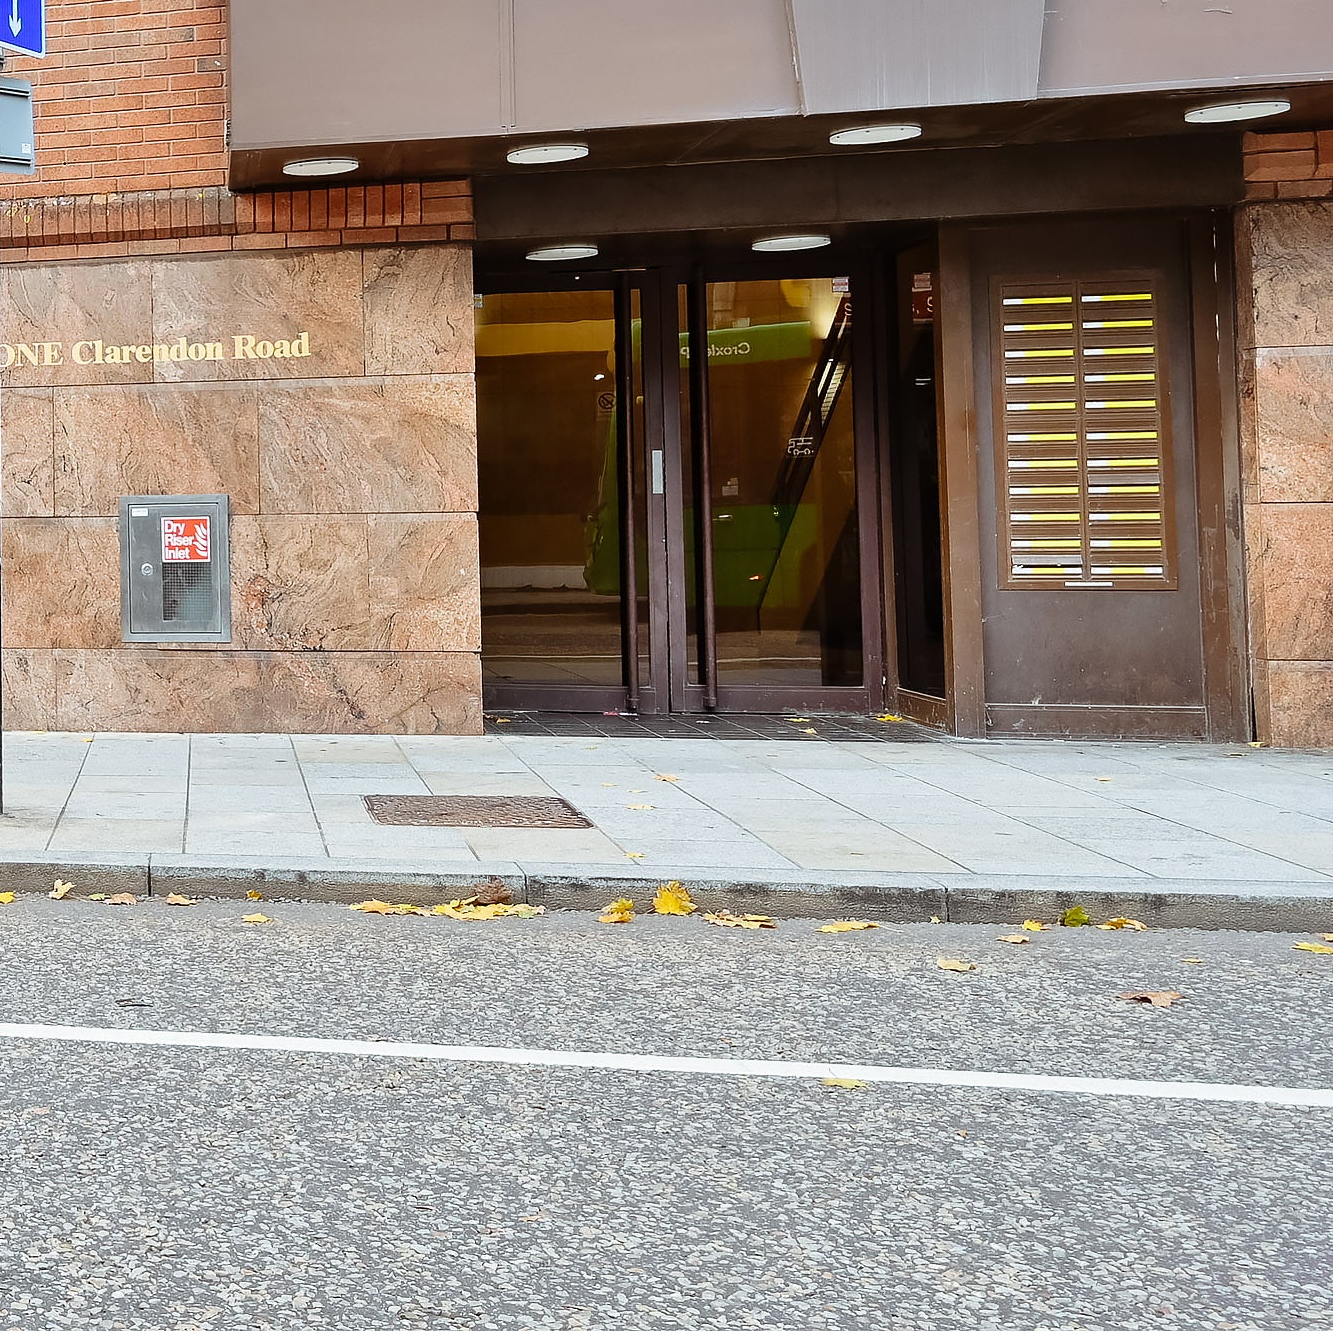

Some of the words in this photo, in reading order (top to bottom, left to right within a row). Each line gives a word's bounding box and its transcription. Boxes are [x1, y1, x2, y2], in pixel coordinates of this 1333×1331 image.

[0, 341, 64, 368] ONE
[71, 337, 224, 365] Clarendon
[231, 332, 311, 360] Road
[164, 520, 186, 536] Dry
[164, 533, 195, 547] Riser
[165, 546, 191, 560] Inlet
